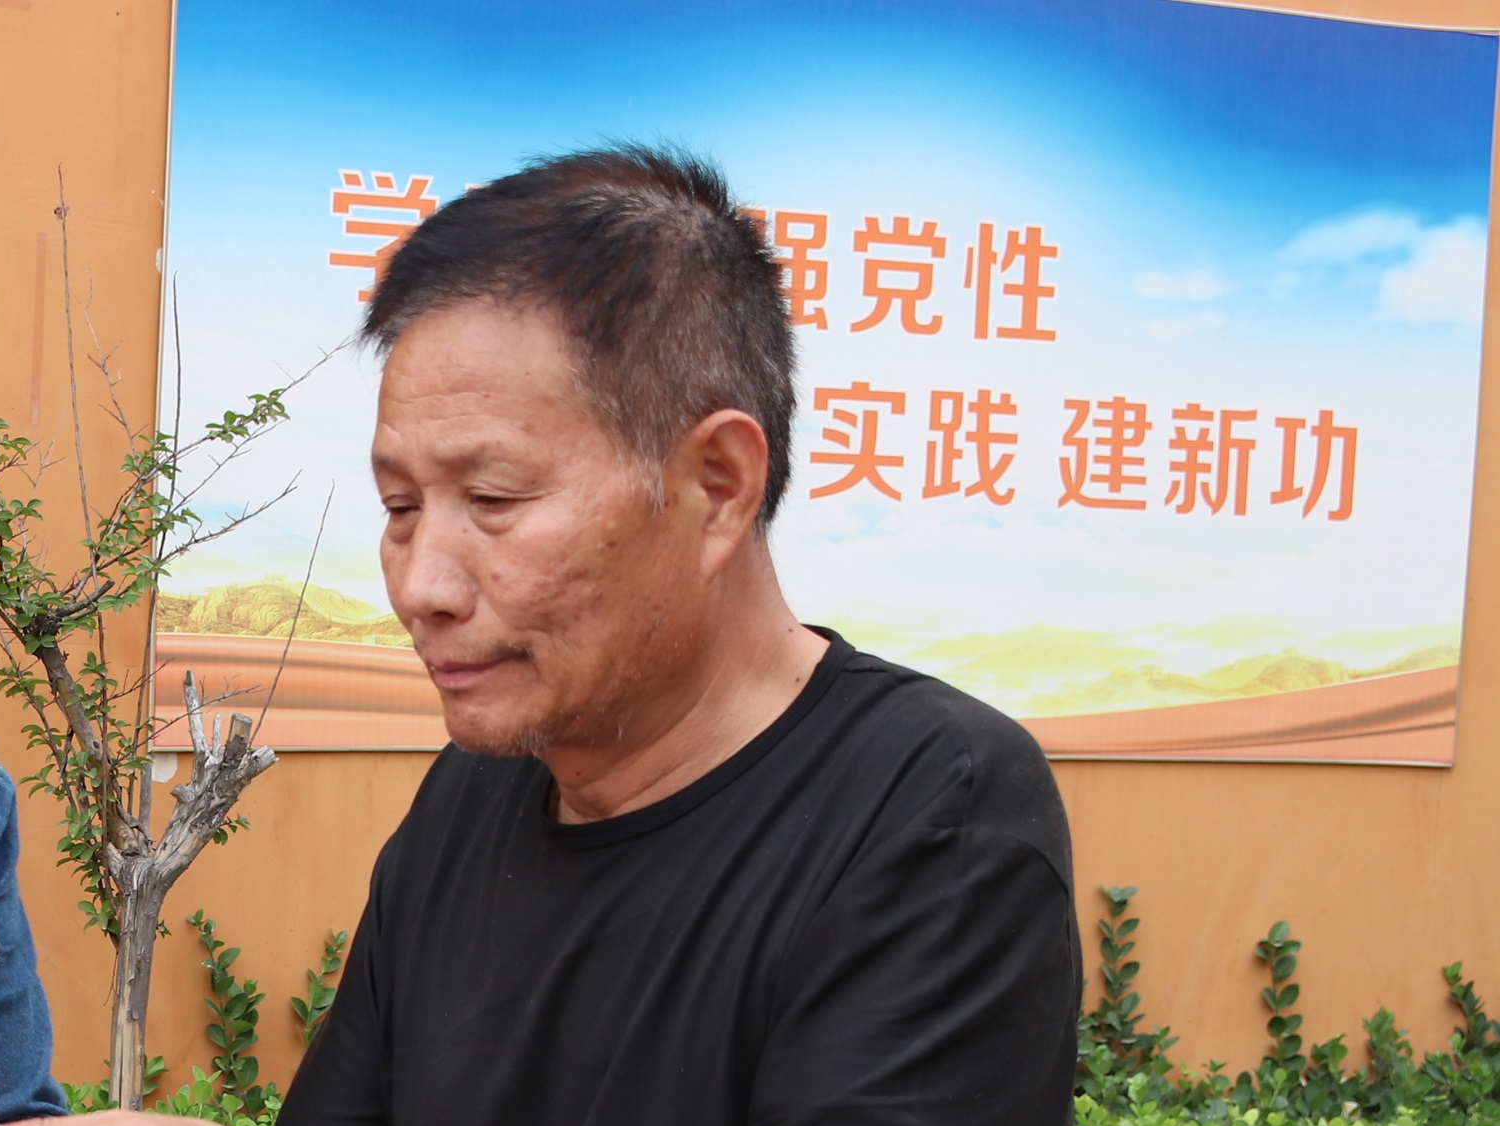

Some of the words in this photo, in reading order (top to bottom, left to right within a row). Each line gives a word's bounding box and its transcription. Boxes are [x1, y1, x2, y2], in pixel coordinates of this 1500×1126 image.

[326, 169, 485, 302] 学
[783, 381, 1018, 506] 实践
[1057, 396, 1358, 521] 建新功
